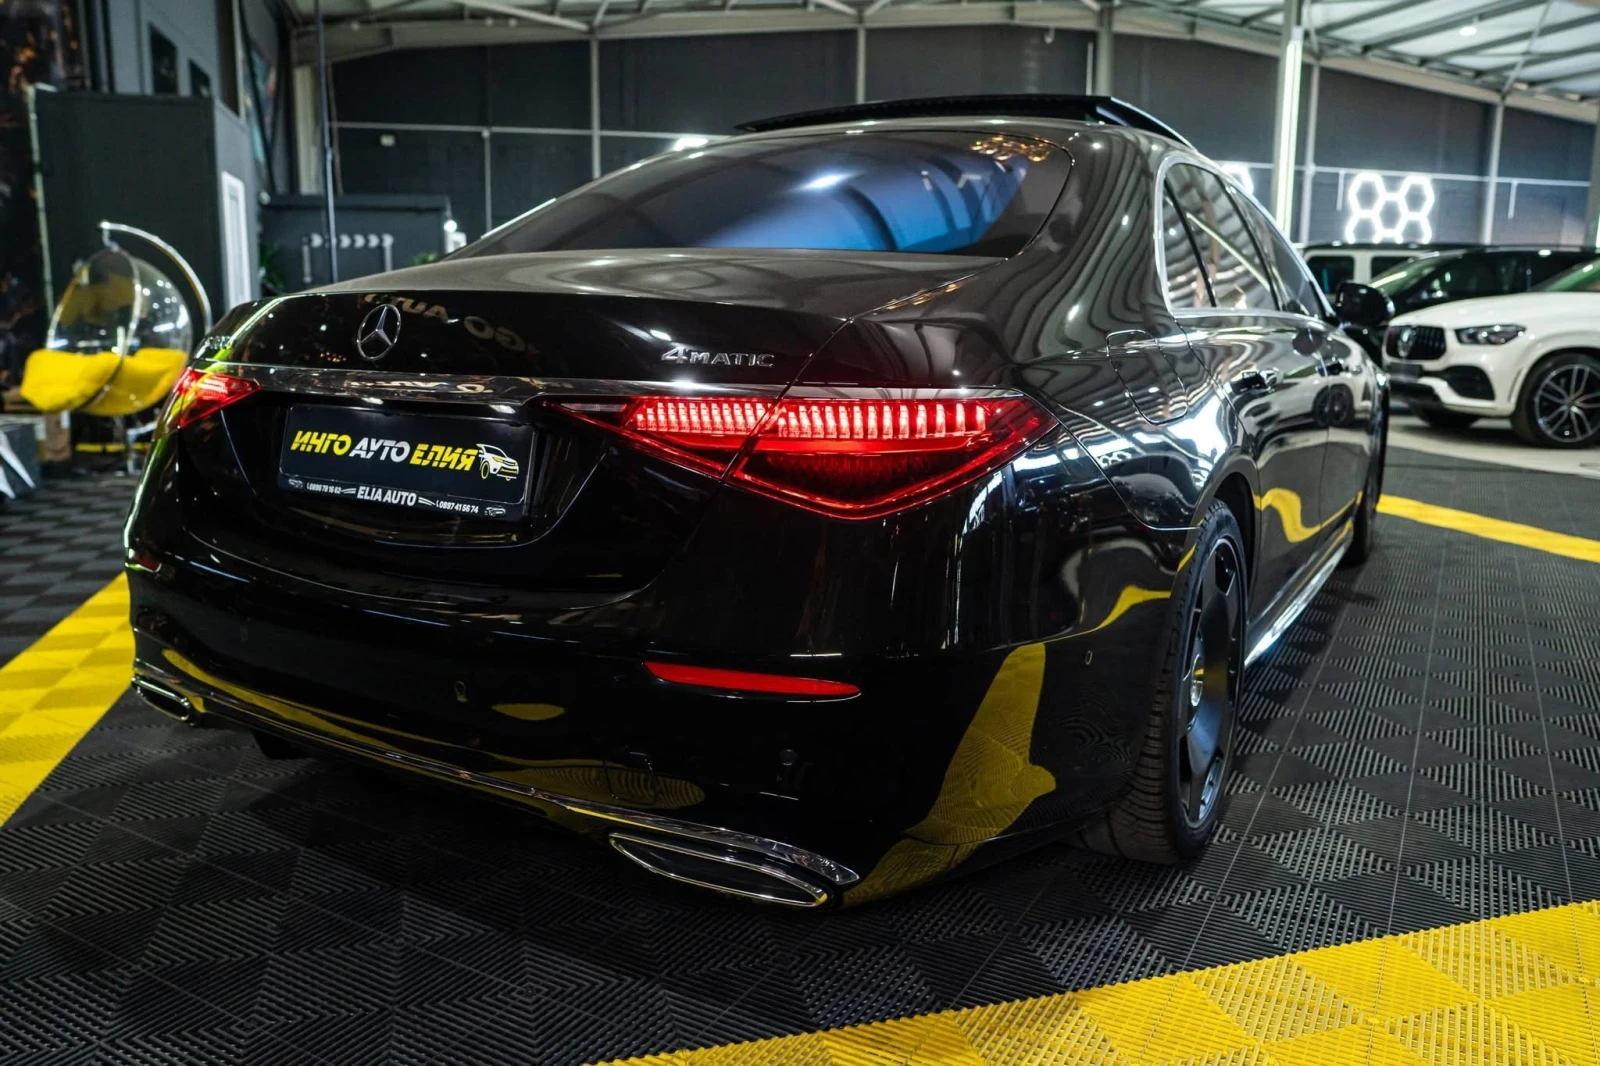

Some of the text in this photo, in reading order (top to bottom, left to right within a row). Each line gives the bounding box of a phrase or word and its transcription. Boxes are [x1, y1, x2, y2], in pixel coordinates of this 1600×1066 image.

[661, 344, 774, 367] 4MATIC
[290, 430, 352, 456] ИНГО
[410, 443, 478, 471] ЕЛИЯ
[357, 486, 382, 501] ELIA
[383, 490, 417, 506] AUTO
[470, 505, 479, 514] 74
